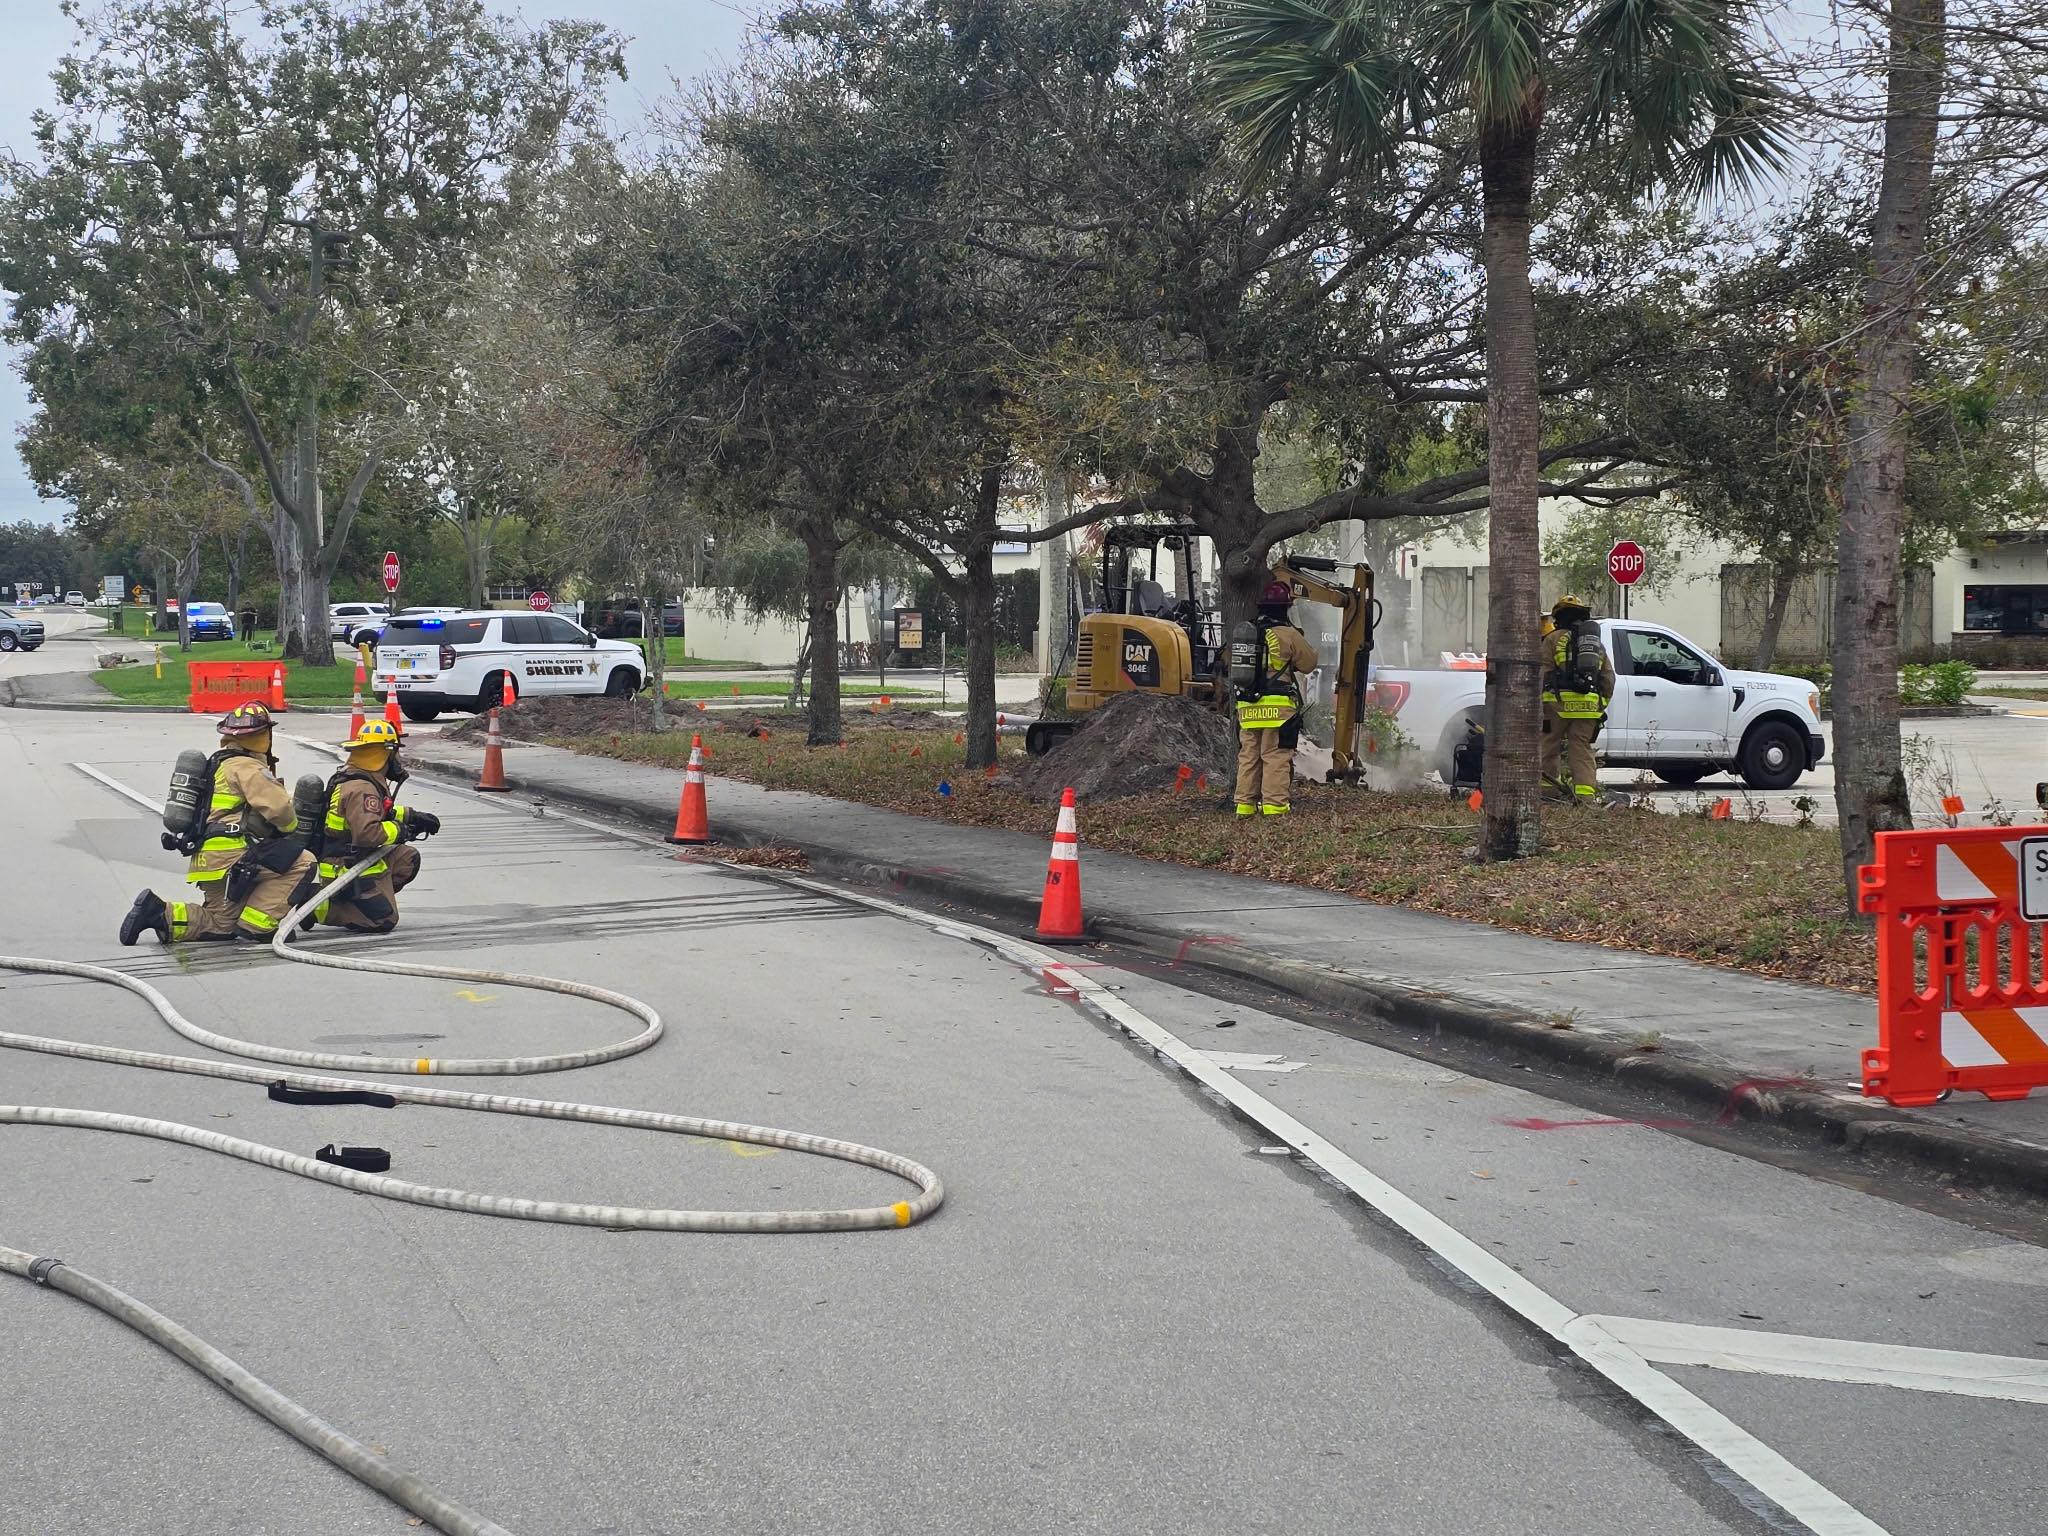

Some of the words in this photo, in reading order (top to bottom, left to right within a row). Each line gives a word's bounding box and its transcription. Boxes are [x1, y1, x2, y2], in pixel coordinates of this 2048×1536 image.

[1611, 555, 1642, 571] STOP
[384, 565, 399, 579] STOP
[531, 597, 549, 606] STOP
[1125, 645, 1152, 661] CAT
[526, 666, 584, 676] SHERIFF
[1128, 664, 1147, 673] 304E
[1241, 707, 1279, 720] LABRADOR
